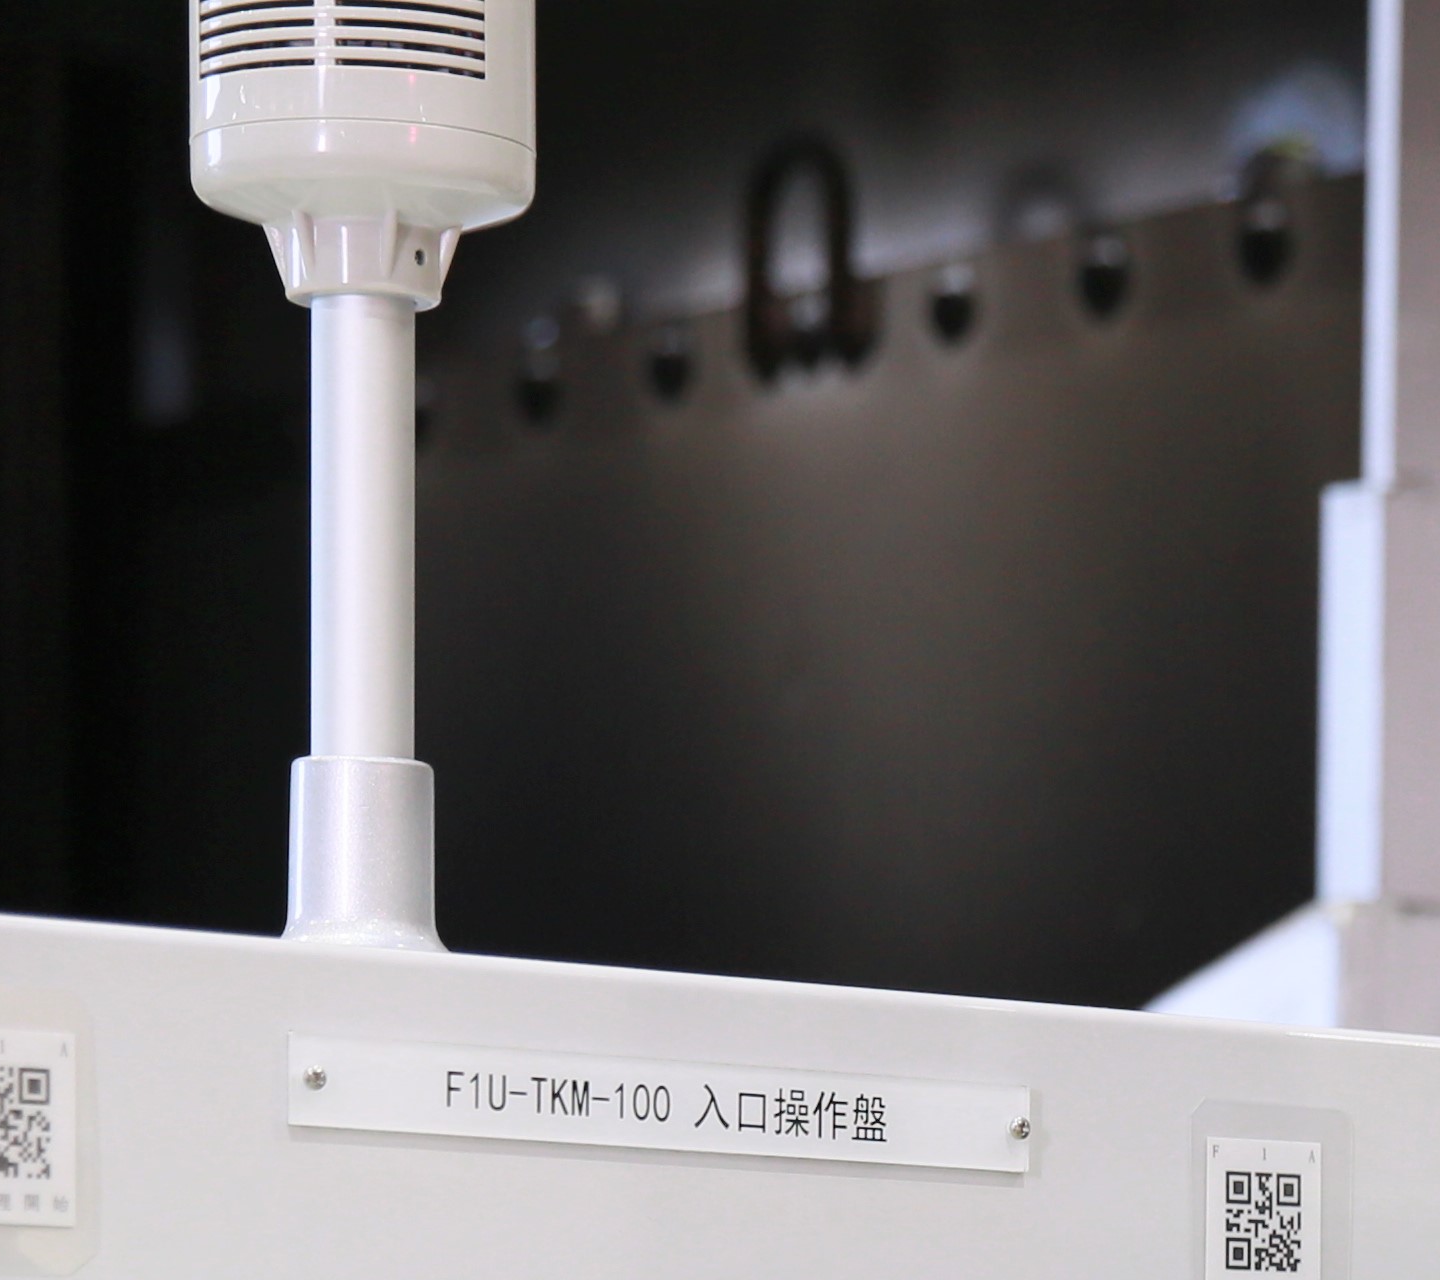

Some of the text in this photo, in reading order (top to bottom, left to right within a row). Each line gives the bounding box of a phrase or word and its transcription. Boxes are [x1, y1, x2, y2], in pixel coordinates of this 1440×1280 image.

[445, 1071, 888, 1143] F1U-TKM-100 入口操作盤
